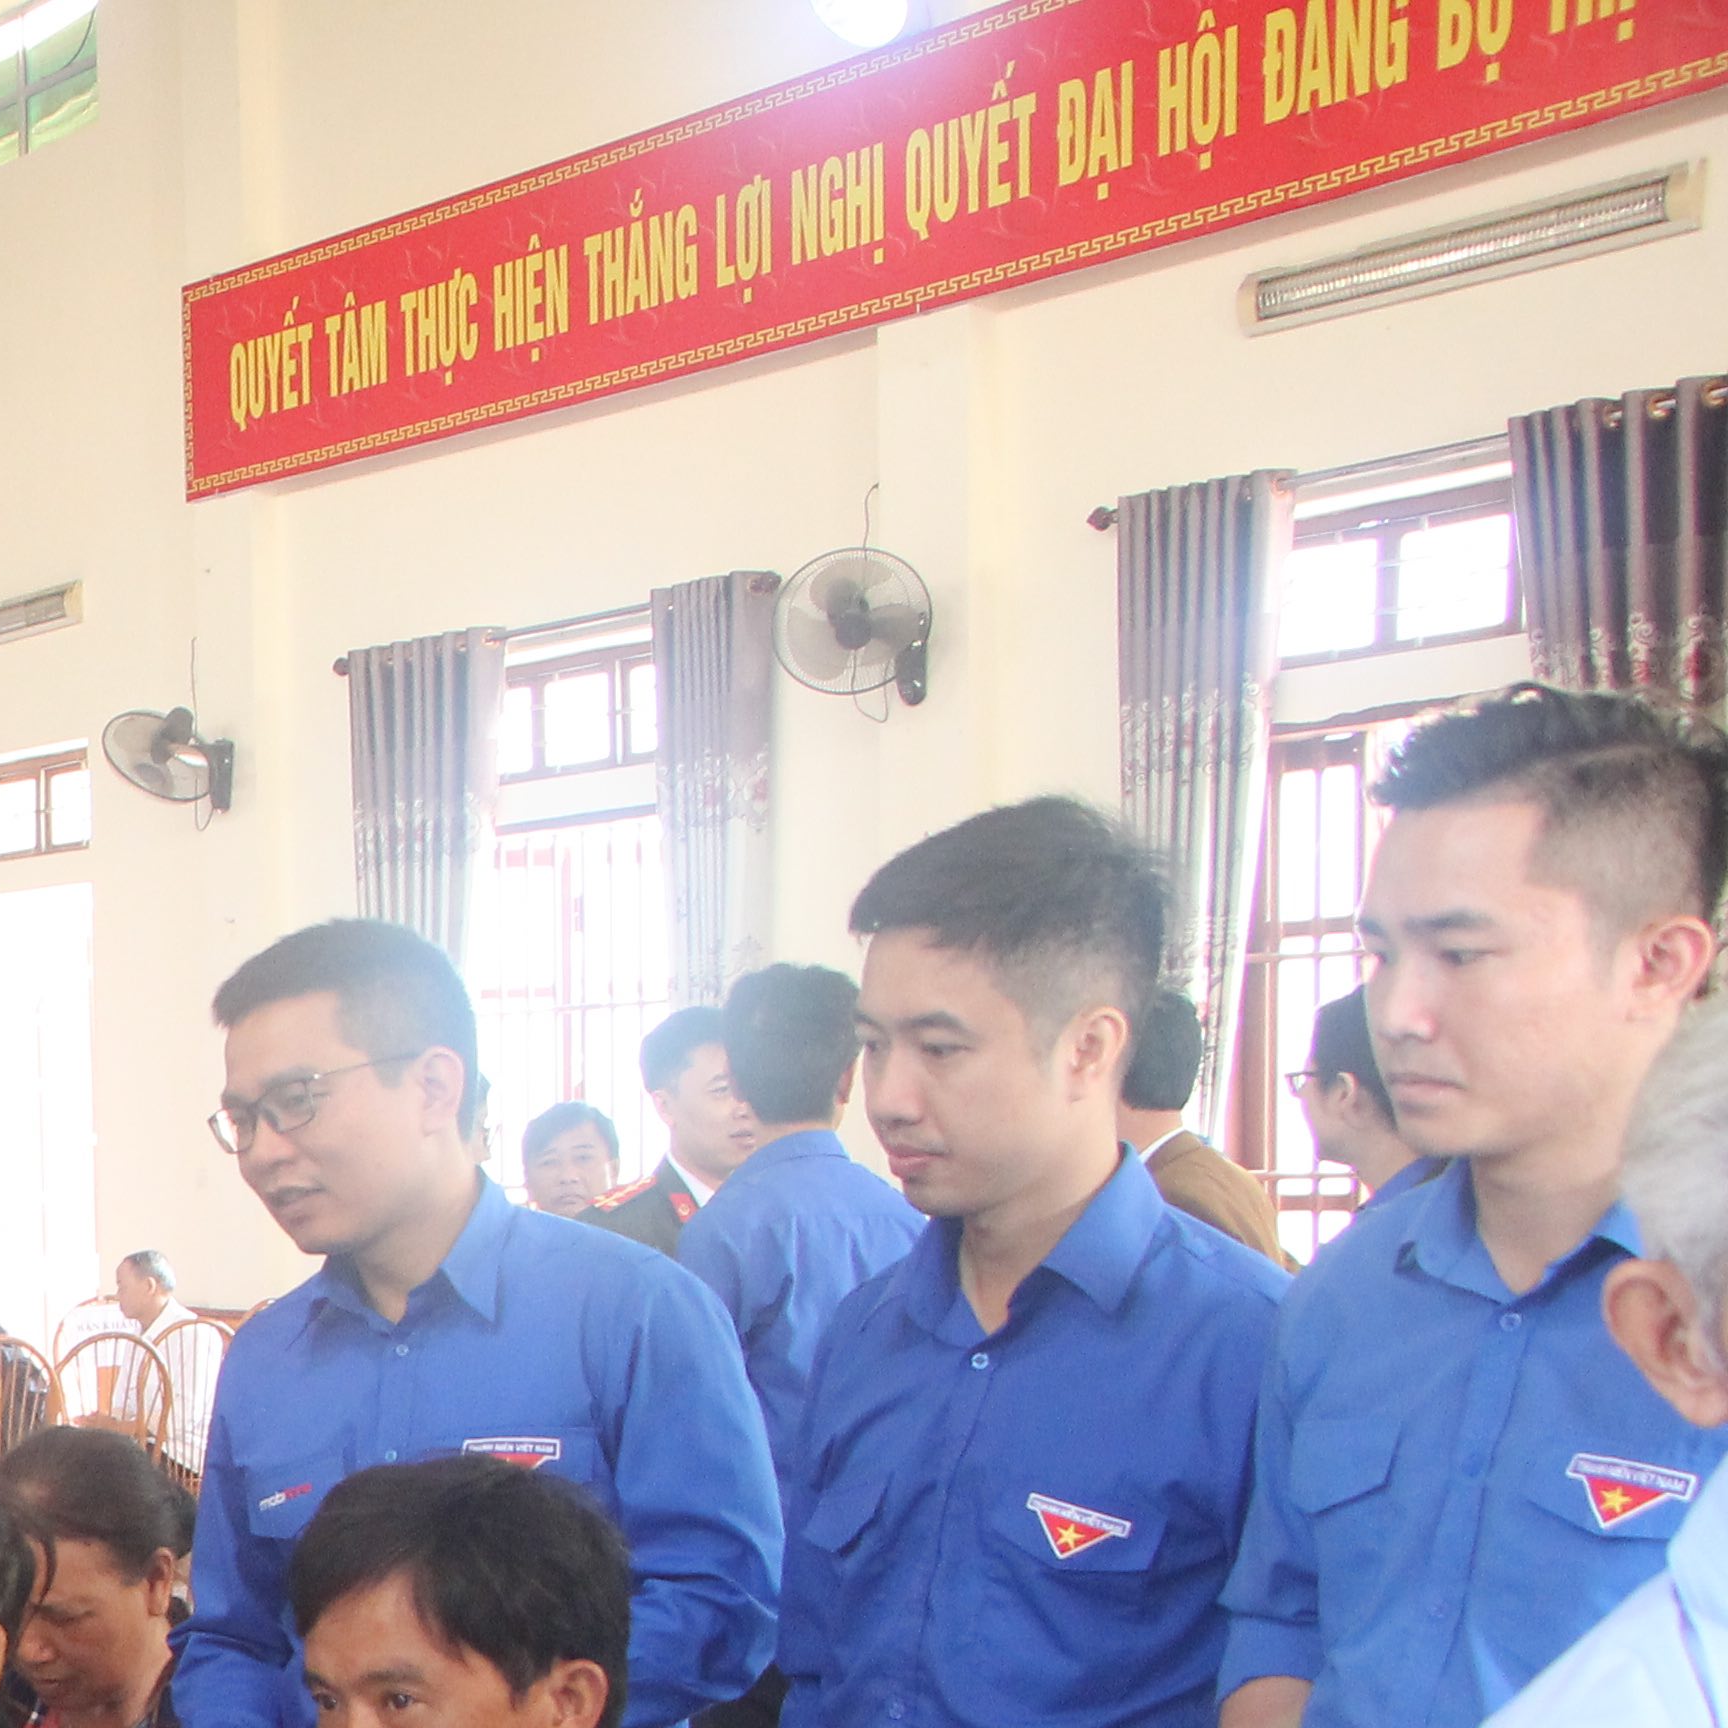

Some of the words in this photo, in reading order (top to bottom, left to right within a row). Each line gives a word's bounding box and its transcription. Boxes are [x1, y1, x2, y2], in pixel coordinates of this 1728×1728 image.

[230, 296, 313, 432] QUYẾT
[325, 292, 388, 397] TÂM
[400, 267, 478, 385] THỰC
[492, 236, 569, 361] HIỆN
[584, 189, 698, 325] THẮNG
[715, 175, 772, 303] LỢI
[791, 142, 885, 264] NGHỊ
[905, 61, 1037, 240] QUYẾT
[1057, 61, 1133, 200] ĐẠI
[1157, 11, 1238, 169] HỘI
